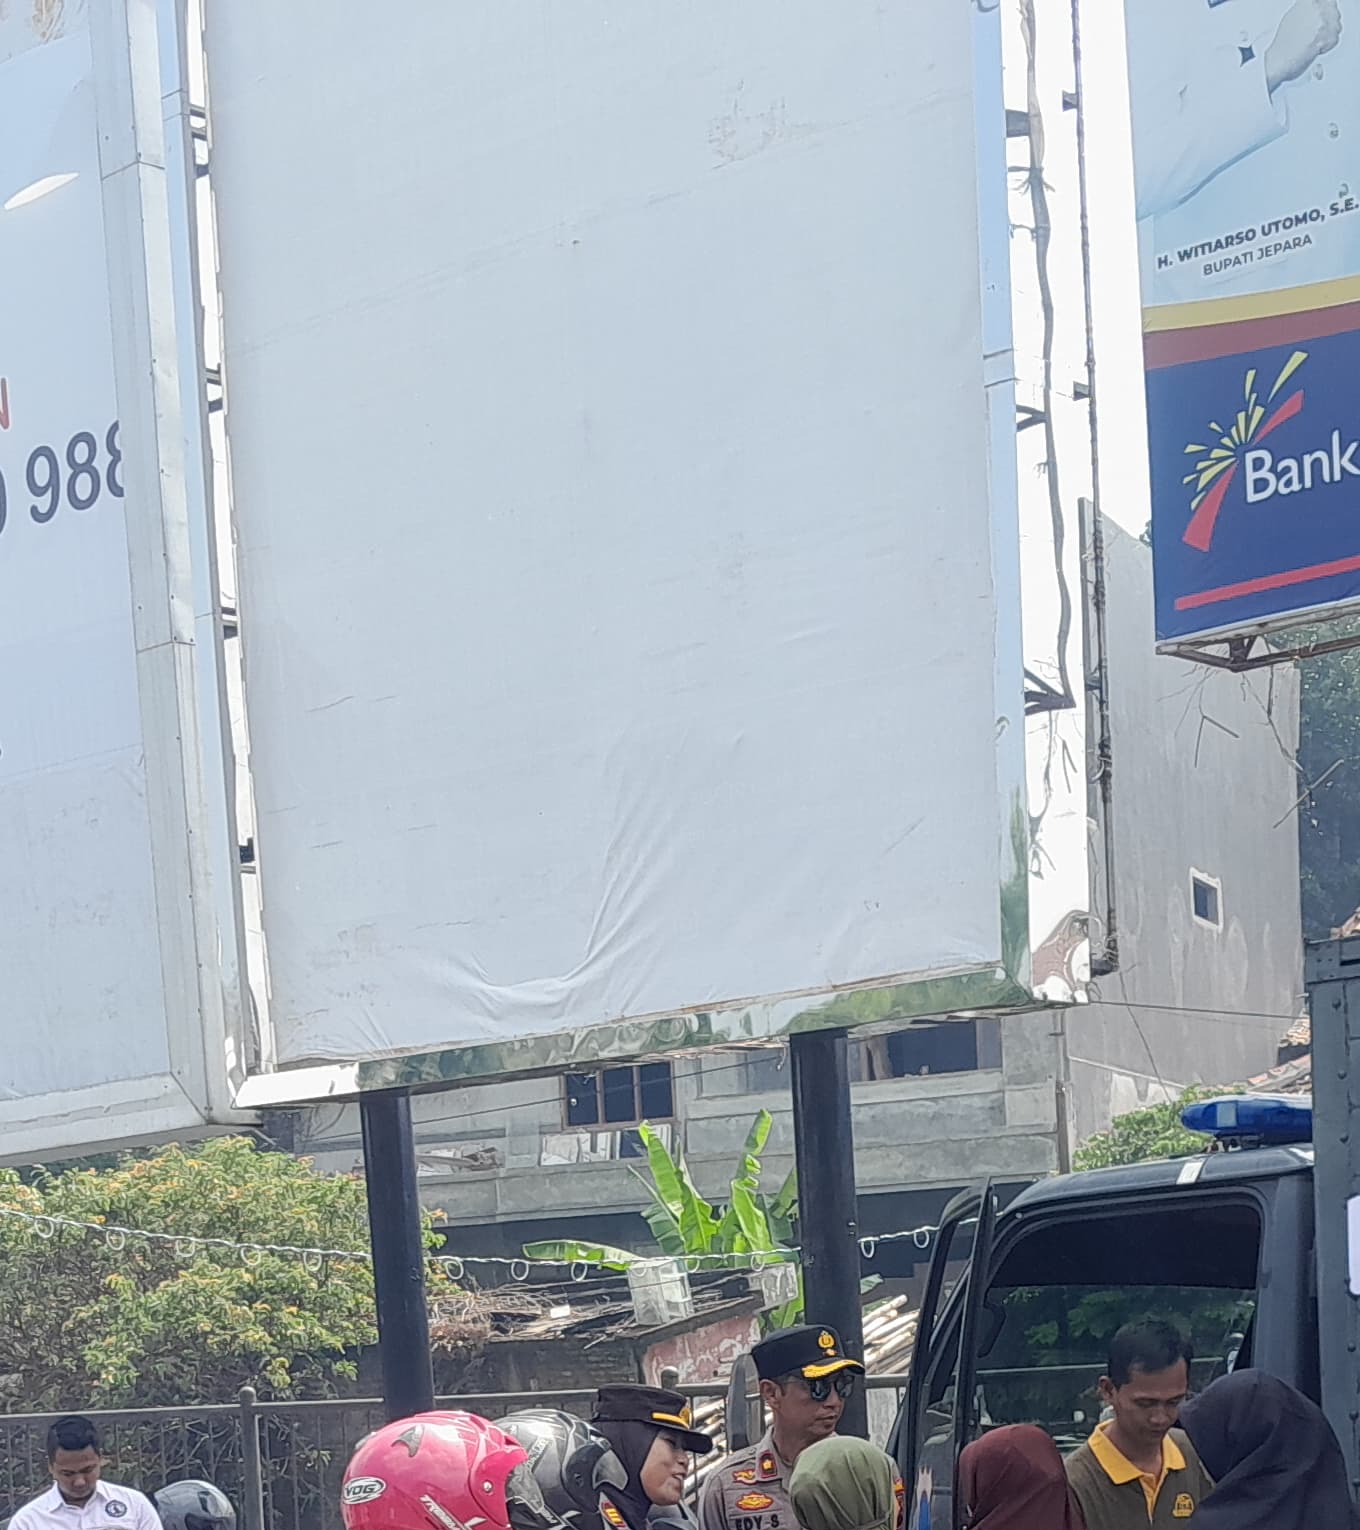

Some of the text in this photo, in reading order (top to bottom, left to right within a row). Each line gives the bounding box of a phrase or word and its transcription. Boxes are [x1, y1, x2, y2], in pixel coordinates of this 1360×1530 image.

[1157, 198, 1360, 269] H. WITIARSO UTOMO, S.E.
[1203, 234, 1313, 276] BUPATI JEPARA
